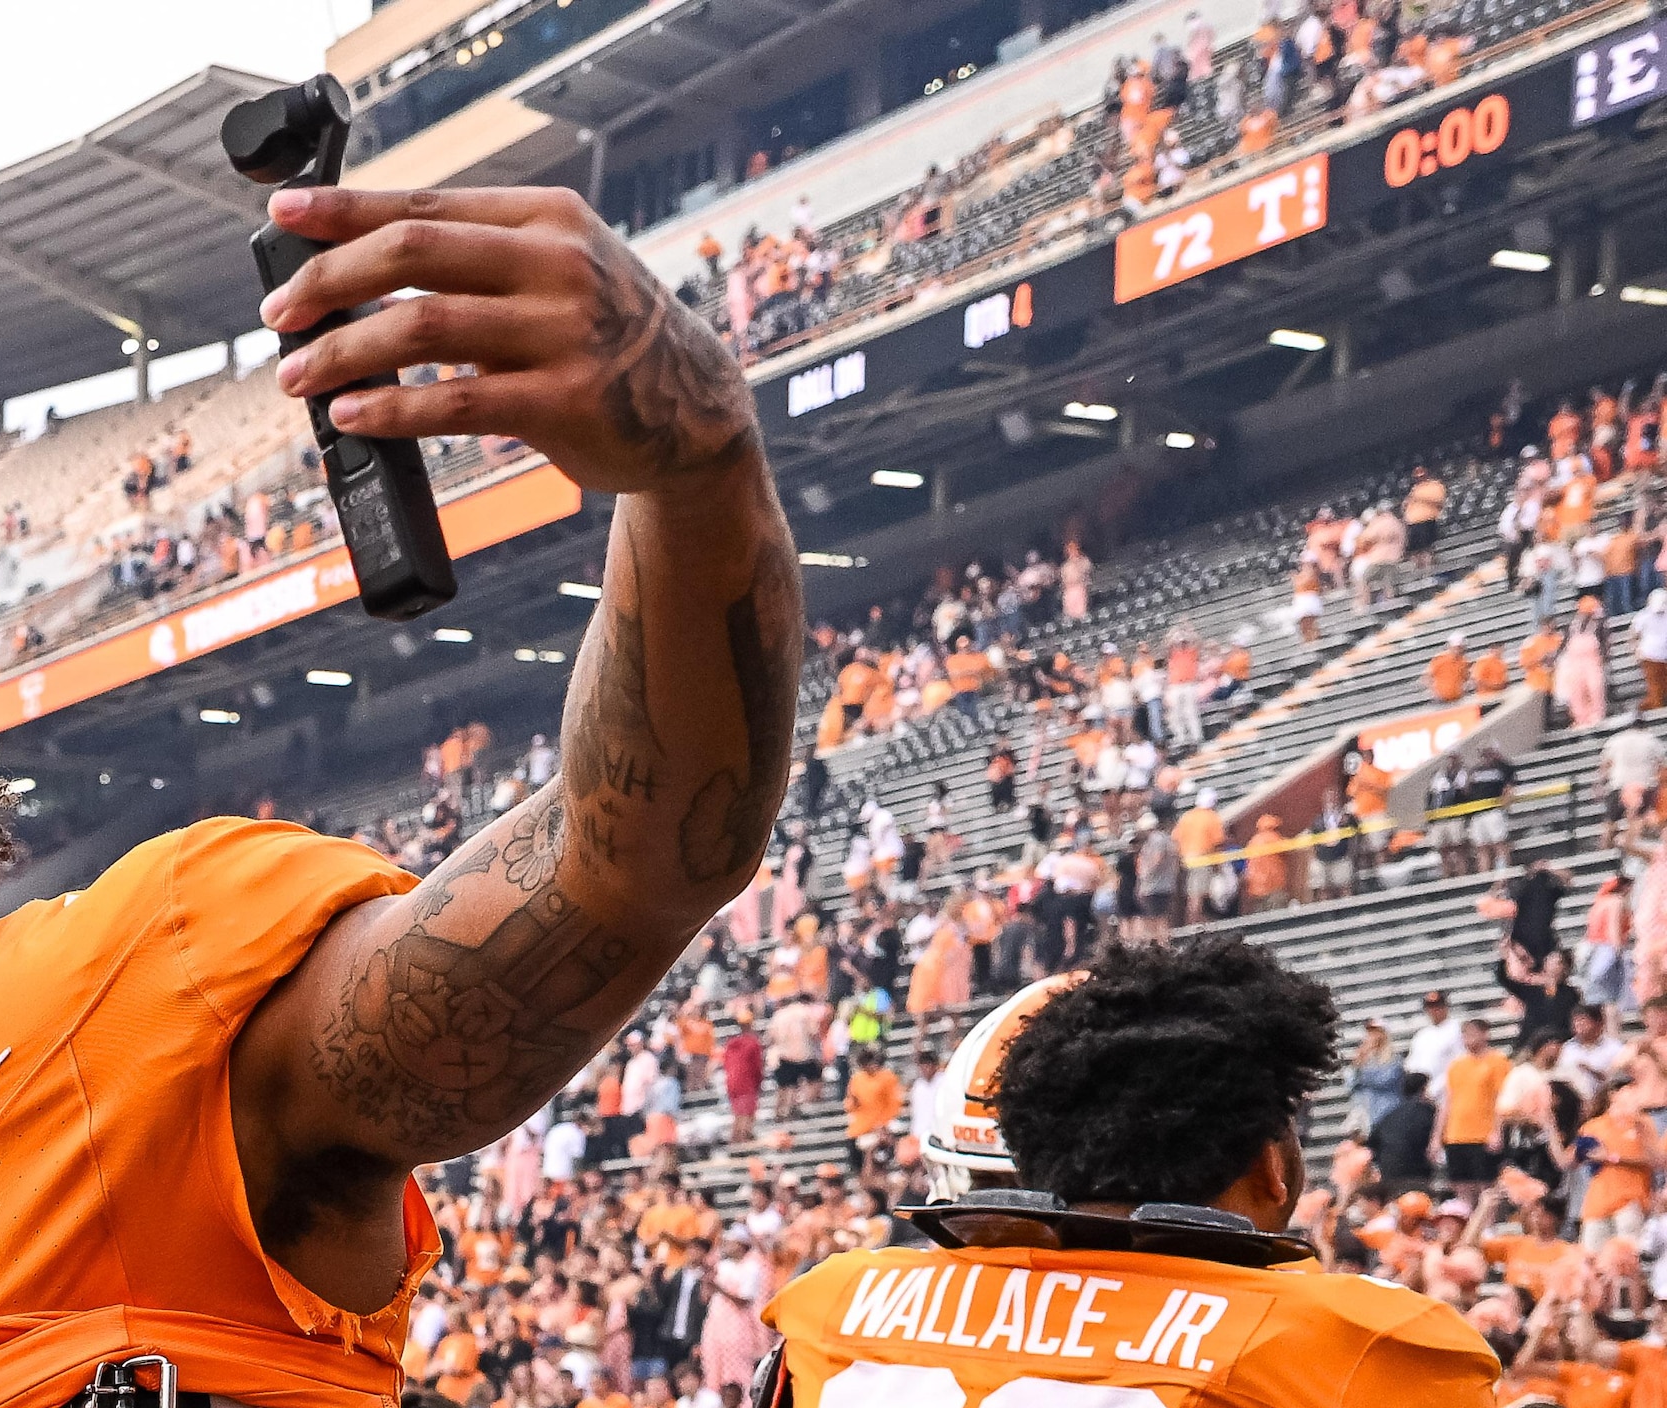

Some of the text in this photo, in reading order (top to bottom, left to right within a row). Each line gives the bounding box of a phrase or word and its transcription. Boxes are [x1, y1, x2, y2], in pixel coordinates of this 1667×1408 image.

[1383, 94, 1511, 189] 0:00
[1152, 213, 1214, 281] 72
[953, 1125, 997, 1144] VOLS
[839, 1262, 1230, 1373] WALLACE JR.
